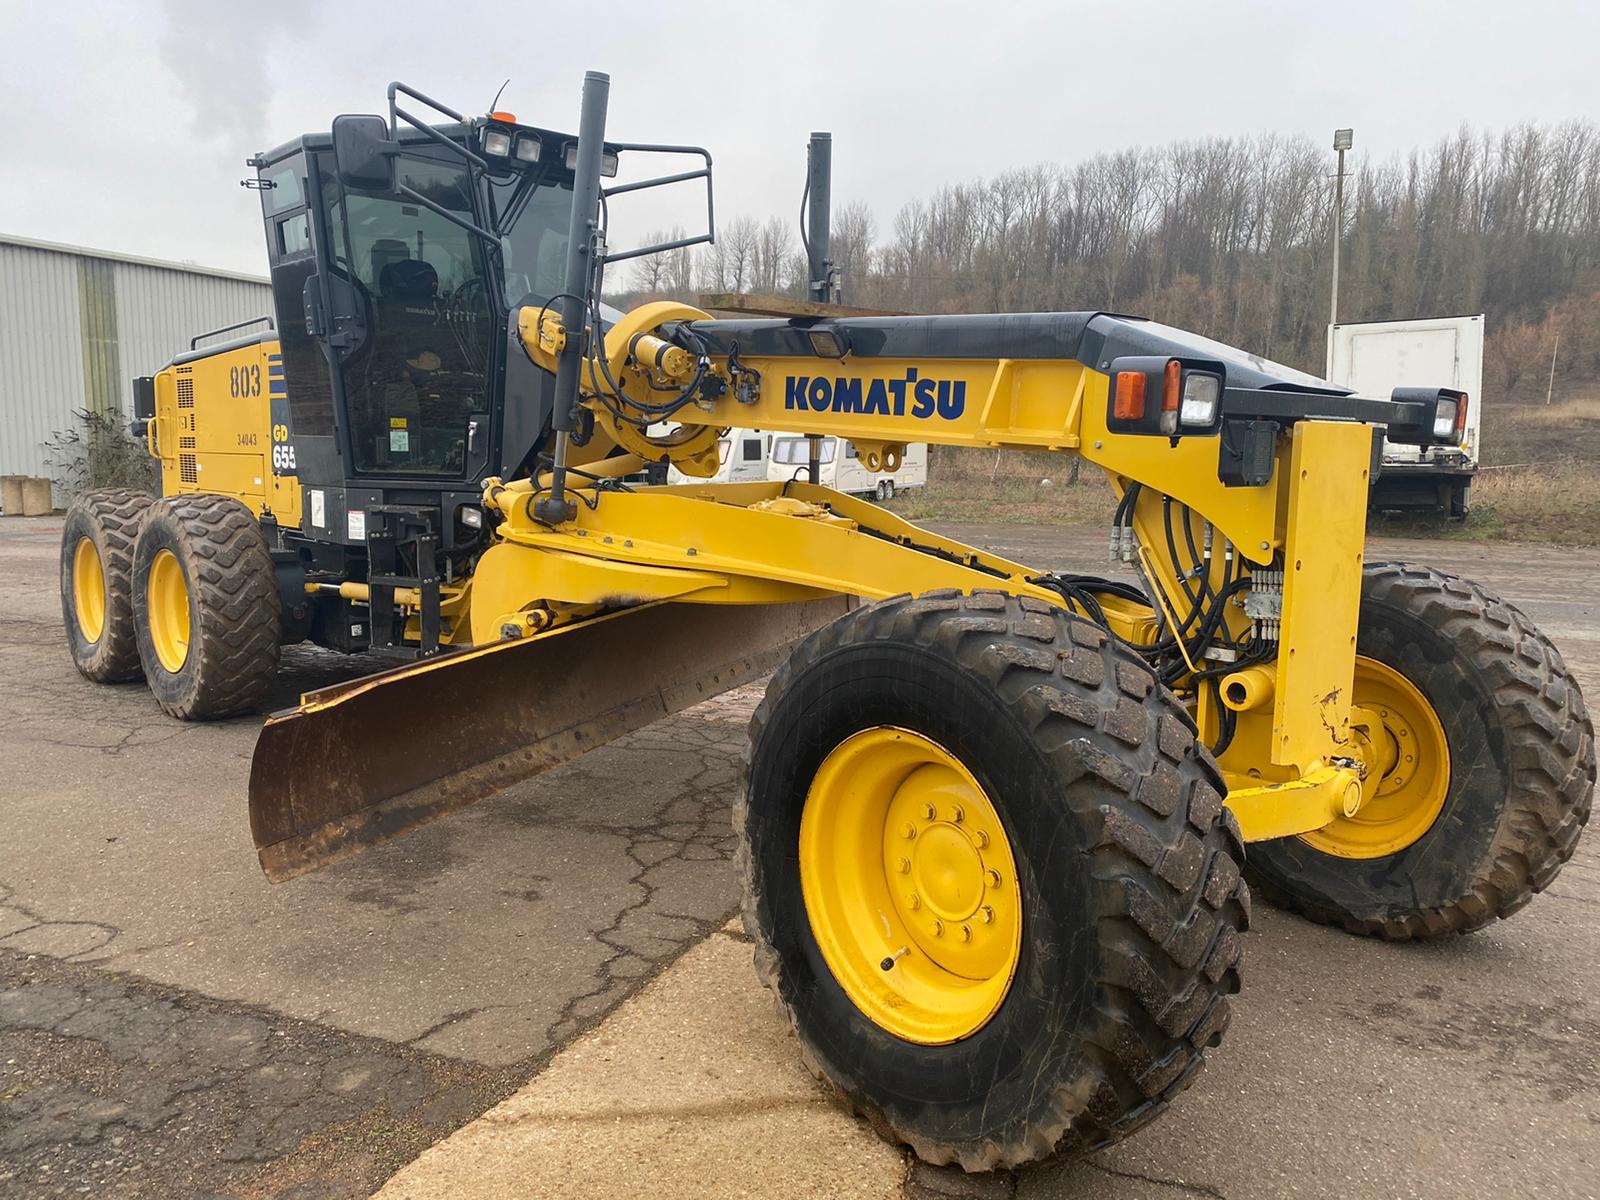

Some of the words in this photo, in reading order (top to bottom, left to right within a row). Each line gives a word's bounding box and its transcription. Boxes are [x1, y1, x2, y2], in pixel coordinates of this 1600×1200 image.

[230, 364, 261, 398] 803
[785, 368, 966, 420] KOMATSU
[237, 434, 257, 446] 34043
[273, 424, 288, 442] GD
[273, 445, 296, 469] 655
